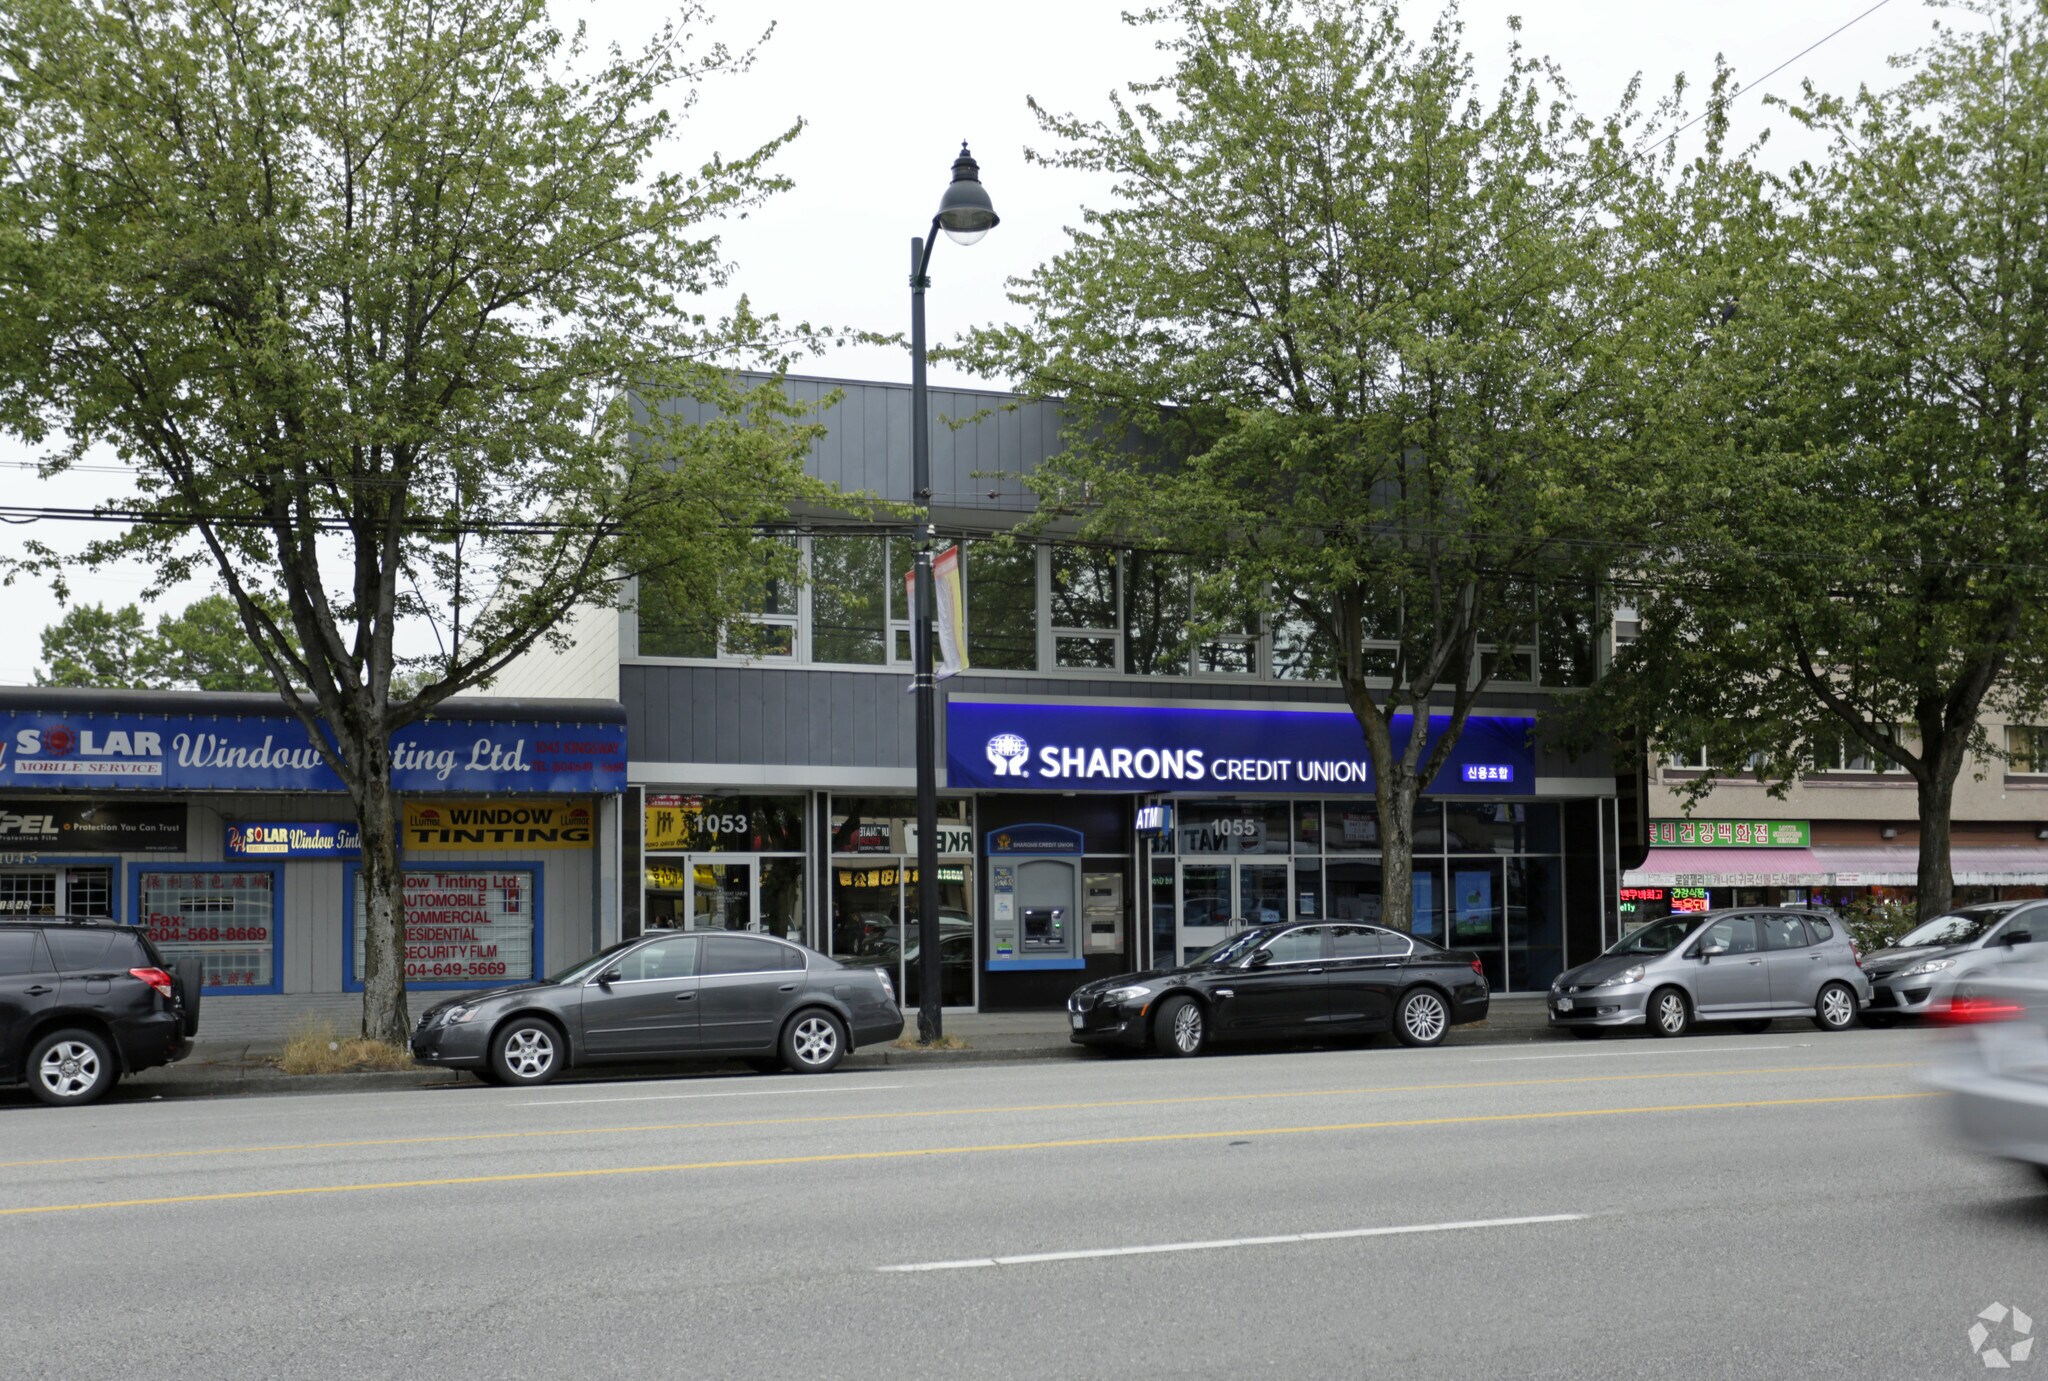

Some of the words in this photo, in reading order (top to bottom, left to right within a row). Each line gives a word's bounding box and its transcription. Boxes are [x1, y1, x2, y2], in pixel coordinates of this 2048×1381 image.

[563, 741, 619, 755] KINGSWAY
[172, 733, 324, 769] Window
[389, 741, 458, 780] ting
[465, 738, 531, 772] Ltd.
[20, 761, 82, 772] MOBILE
[88, 762, 158, 774] SERVICE
[1039, 747, 1204, 781] SHARONS
[1211, 758, 1290, 782] CREDIT
[1297, 760, 1367, 783] UNION
[1467, 766, 1508, 780] 신용조합
[450, 809, 553, 825] WINDOW
[693, 814, 748, 833] 1053
[1135, 806, 1158, 830] ATM
[73, 823, 117, 832] Protection
[121, 824, 136, 832] You
[139, 823, 156, 832] Can
[159, 824, 179, 832] Trust
[246, 826, 288, 843] SOLAR
[1211, 818, 1255, 836] 1055
[290, 829, 335, 849] Window
[411, 828, 590, 843] TINTING
[435, 875, 487, 891] Tinting
[493, 875, 520, 889] Ltd.
[150, 913, 186, 927] Fax:
[148, 927, 267, 941] 604-568-8669
[470, 945, 497, 958] FILM
